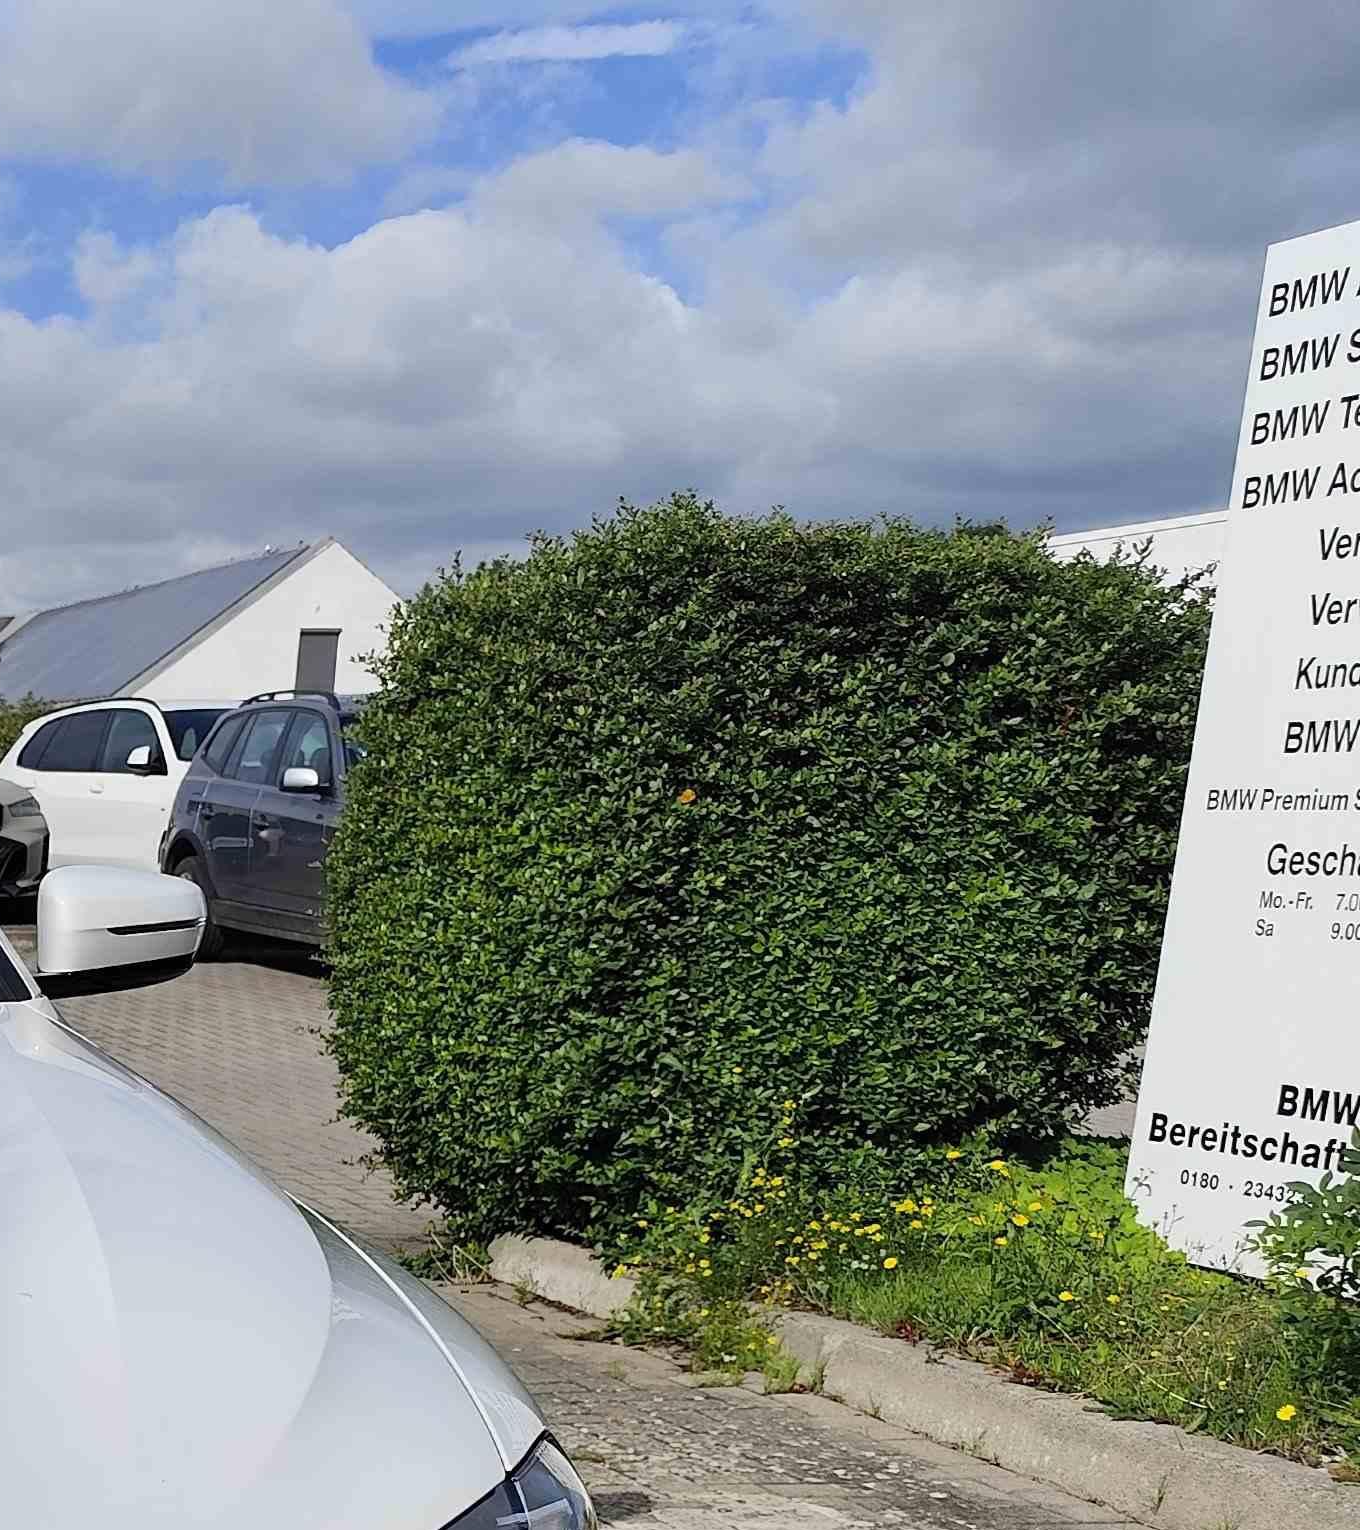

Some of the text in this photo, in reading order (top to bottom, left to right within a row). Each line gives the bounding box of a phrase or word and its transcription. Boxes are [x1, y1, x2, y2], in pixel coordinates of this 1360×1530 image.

[1269, 267, 1350, 317] BMW
[1260, 333, 1340, 381] BMW
[1251, 400, 1331, 445] BMW
[1242, 466, 1321, 509] BMW
[1312, 593, 1360, 625] Ver
[1284, 720, 1360, 753] BMW
[1206, 789, 1258, 810] BMW
[1260, 788, 1349, 811] Premium
[1267, 843, 1360, 876] Gesch
[1336, 893, 1360, 911] 7.0
[1255, 919, 1274, 936] Sa
[1277, 1084, 1360, 1126] BMW
[1180, 1169, 1219, 1190] 0180
